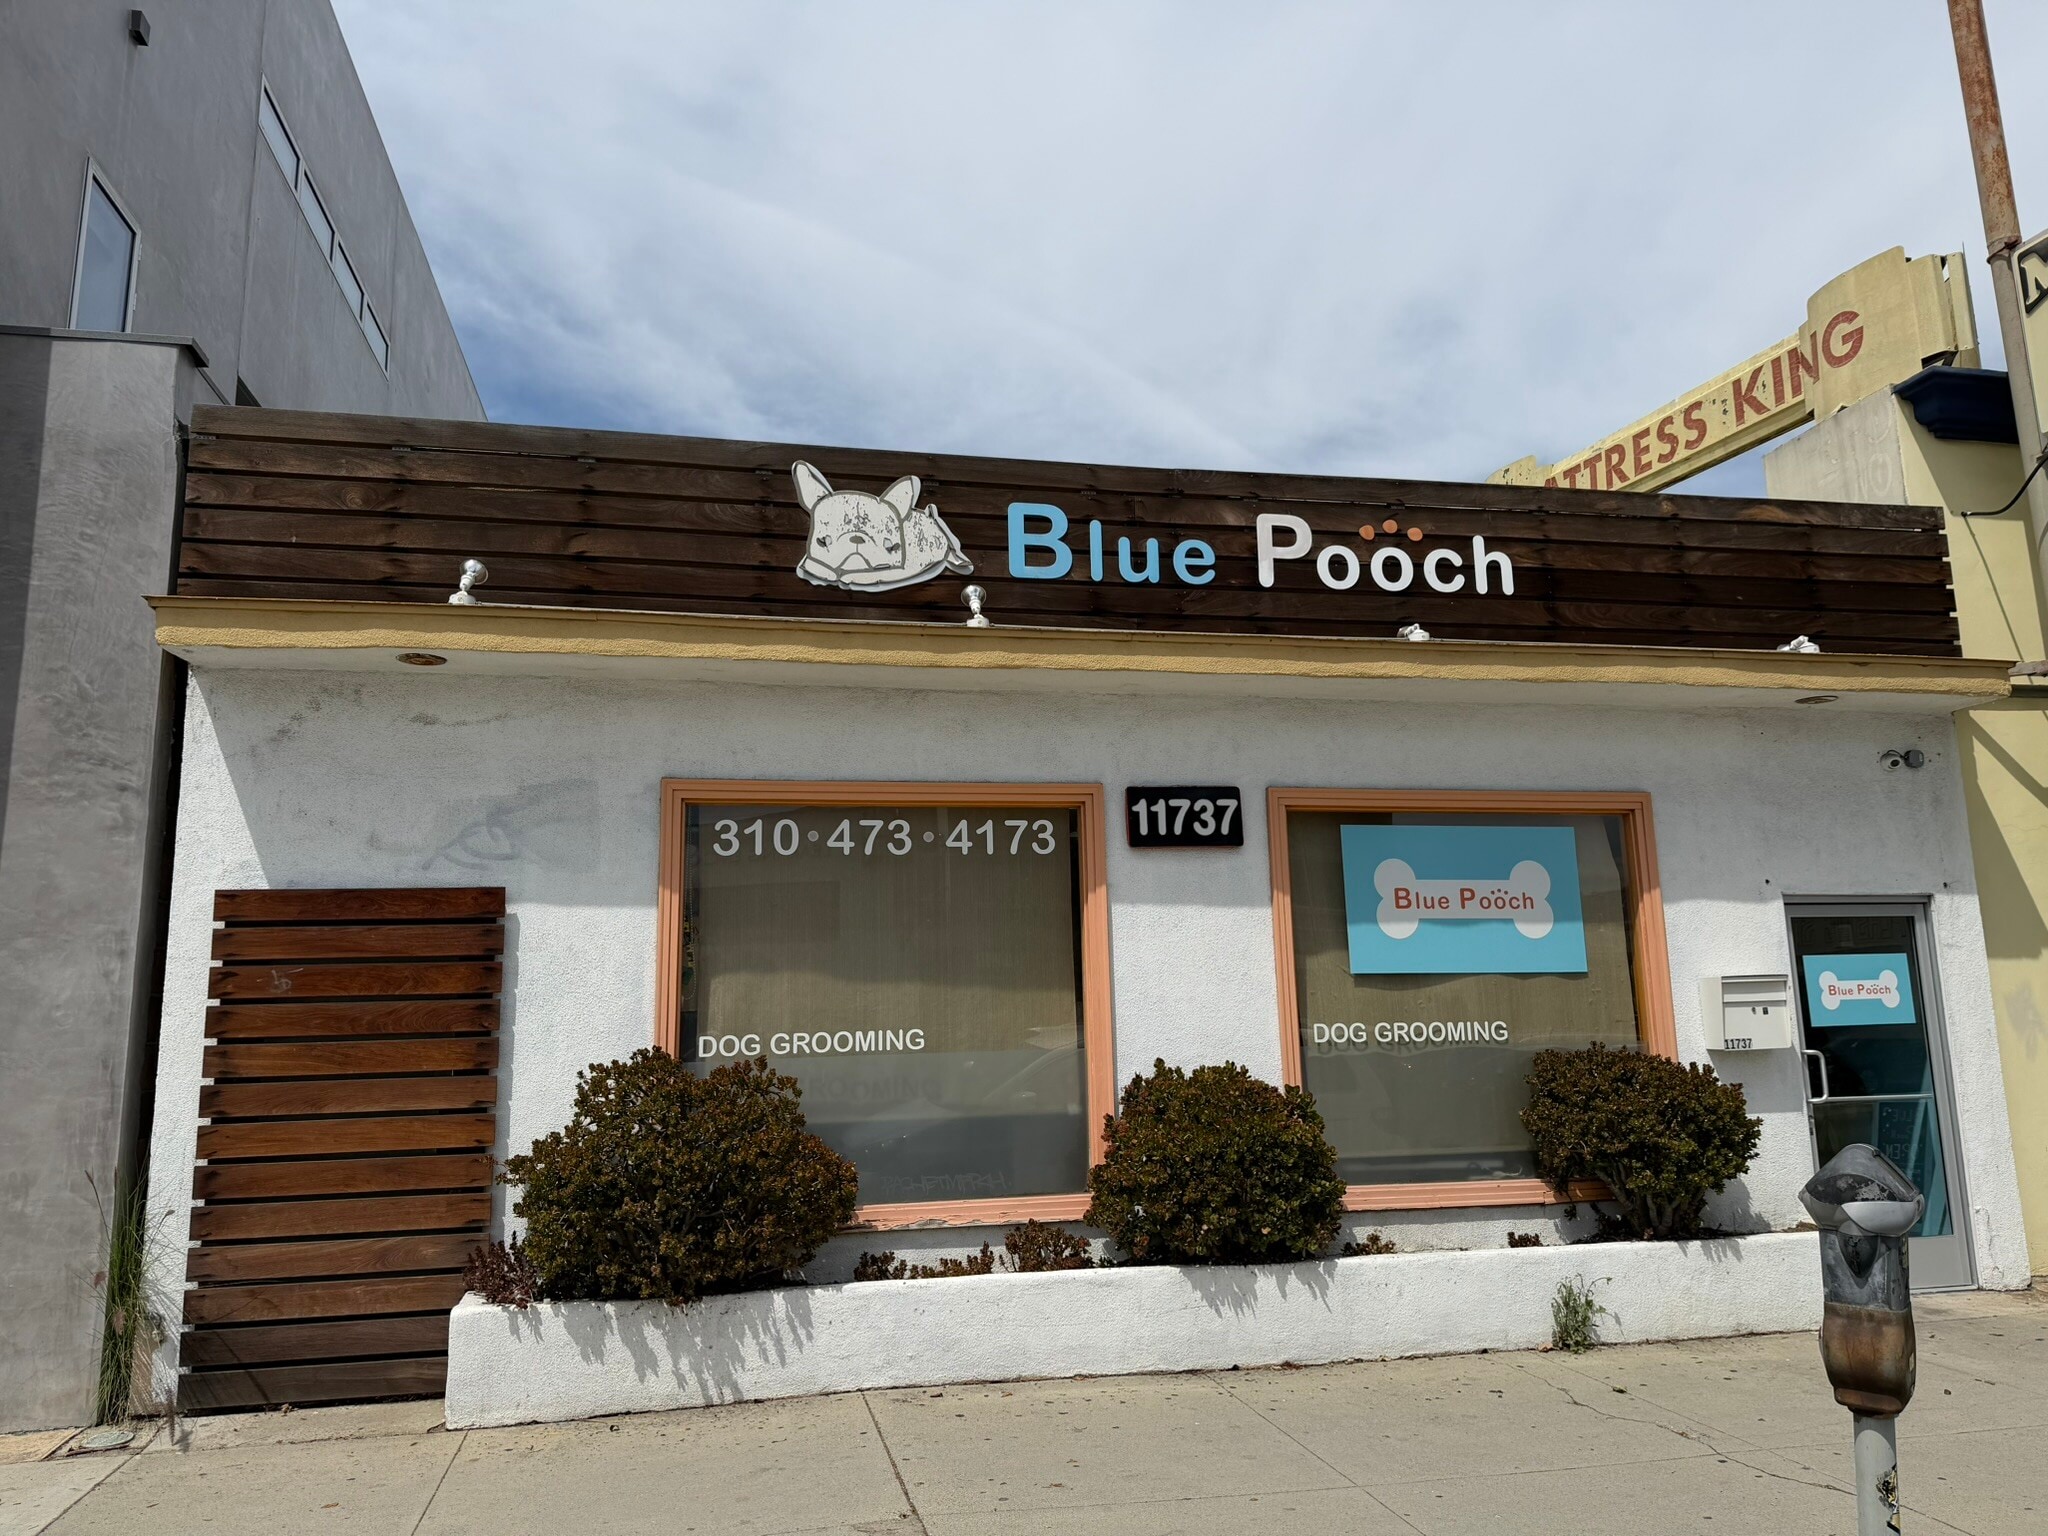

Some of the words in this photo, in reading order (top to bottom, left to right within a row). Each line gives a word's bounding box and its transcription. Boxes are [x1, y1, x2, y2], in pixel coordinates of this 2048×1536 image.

[1732, 310, 1864, 427] KING
[1007, 502, 1216, 585] Blue
[1256, 513, 1515, 596] Pooch
[1131, 798, 1238, 836] 11737
[1394, 887, 1450, 910] Blue
[1459, 887, 1535, 910] Pooch
[1828, 985, 1854, 996] Blue
[1857, 983, 1891, 995] Pooch
[698, 1034, 761, 1058] DOG
[770, 1028, 925, 1055] GROOMING
[1313, 1023, 1367, 1043] DOG
[1374, 1021, 1508, 1043] GROOMING
[1724, 1038, 1752, 1050] 11737
